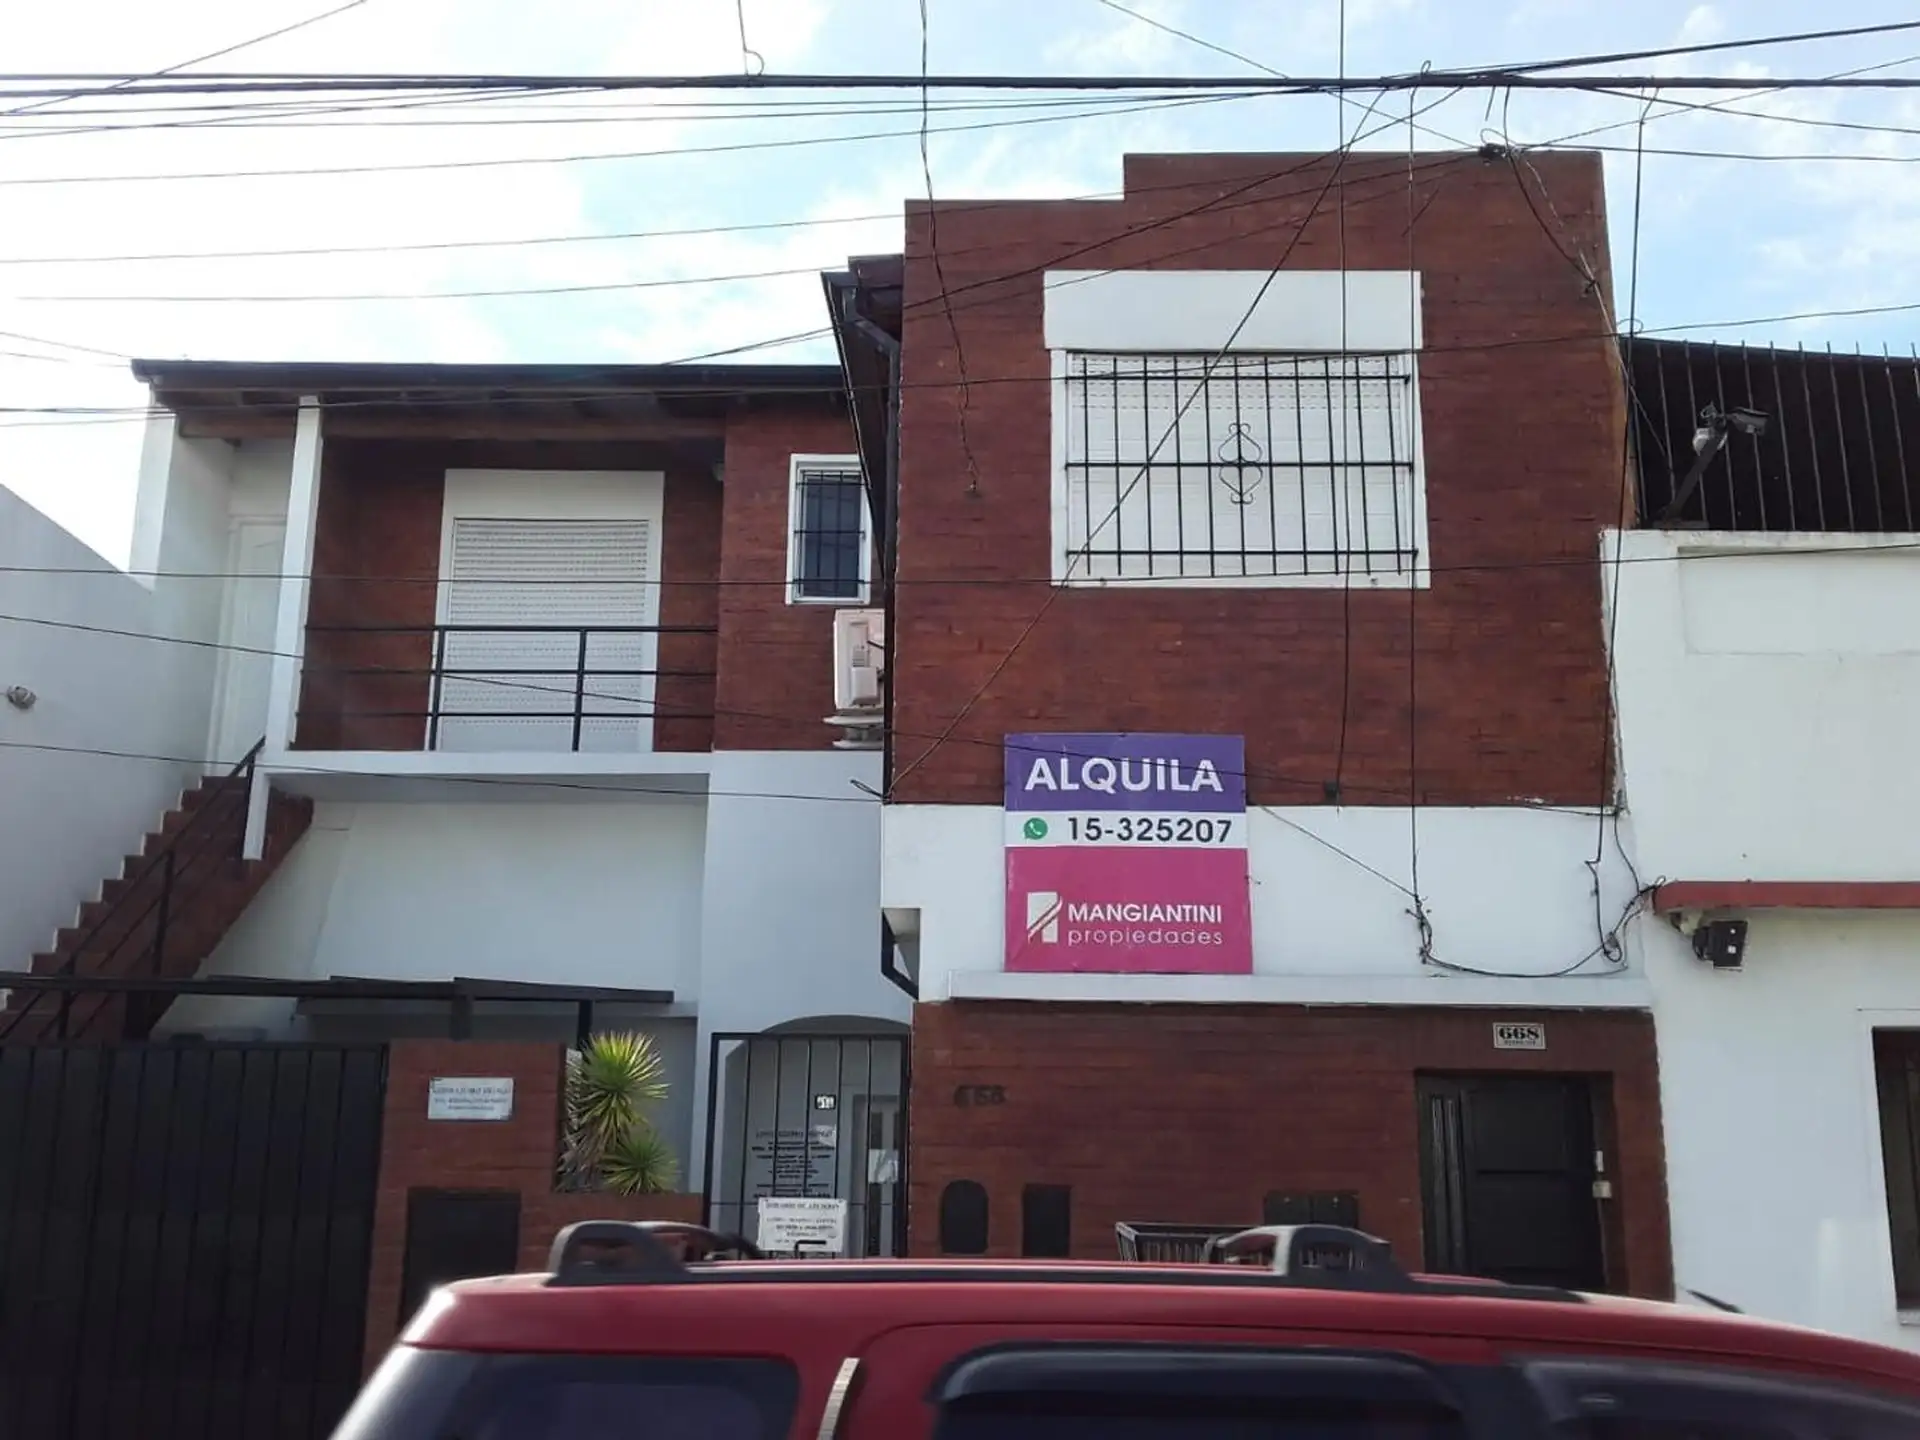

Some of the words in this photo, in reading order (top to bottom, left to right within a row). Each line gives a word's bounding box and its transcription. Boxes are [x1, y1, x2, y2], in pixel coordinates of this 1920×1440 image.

[1024, 757, 1224, 794] ALQUILA
[1067, 817, 1233, 843] 15-325207
[1068, 903, 1222, 923] MANGIANTINI
[1068, 927, 1222, 947] propiedades
[1499, 1027, 1539, 1040] 668
